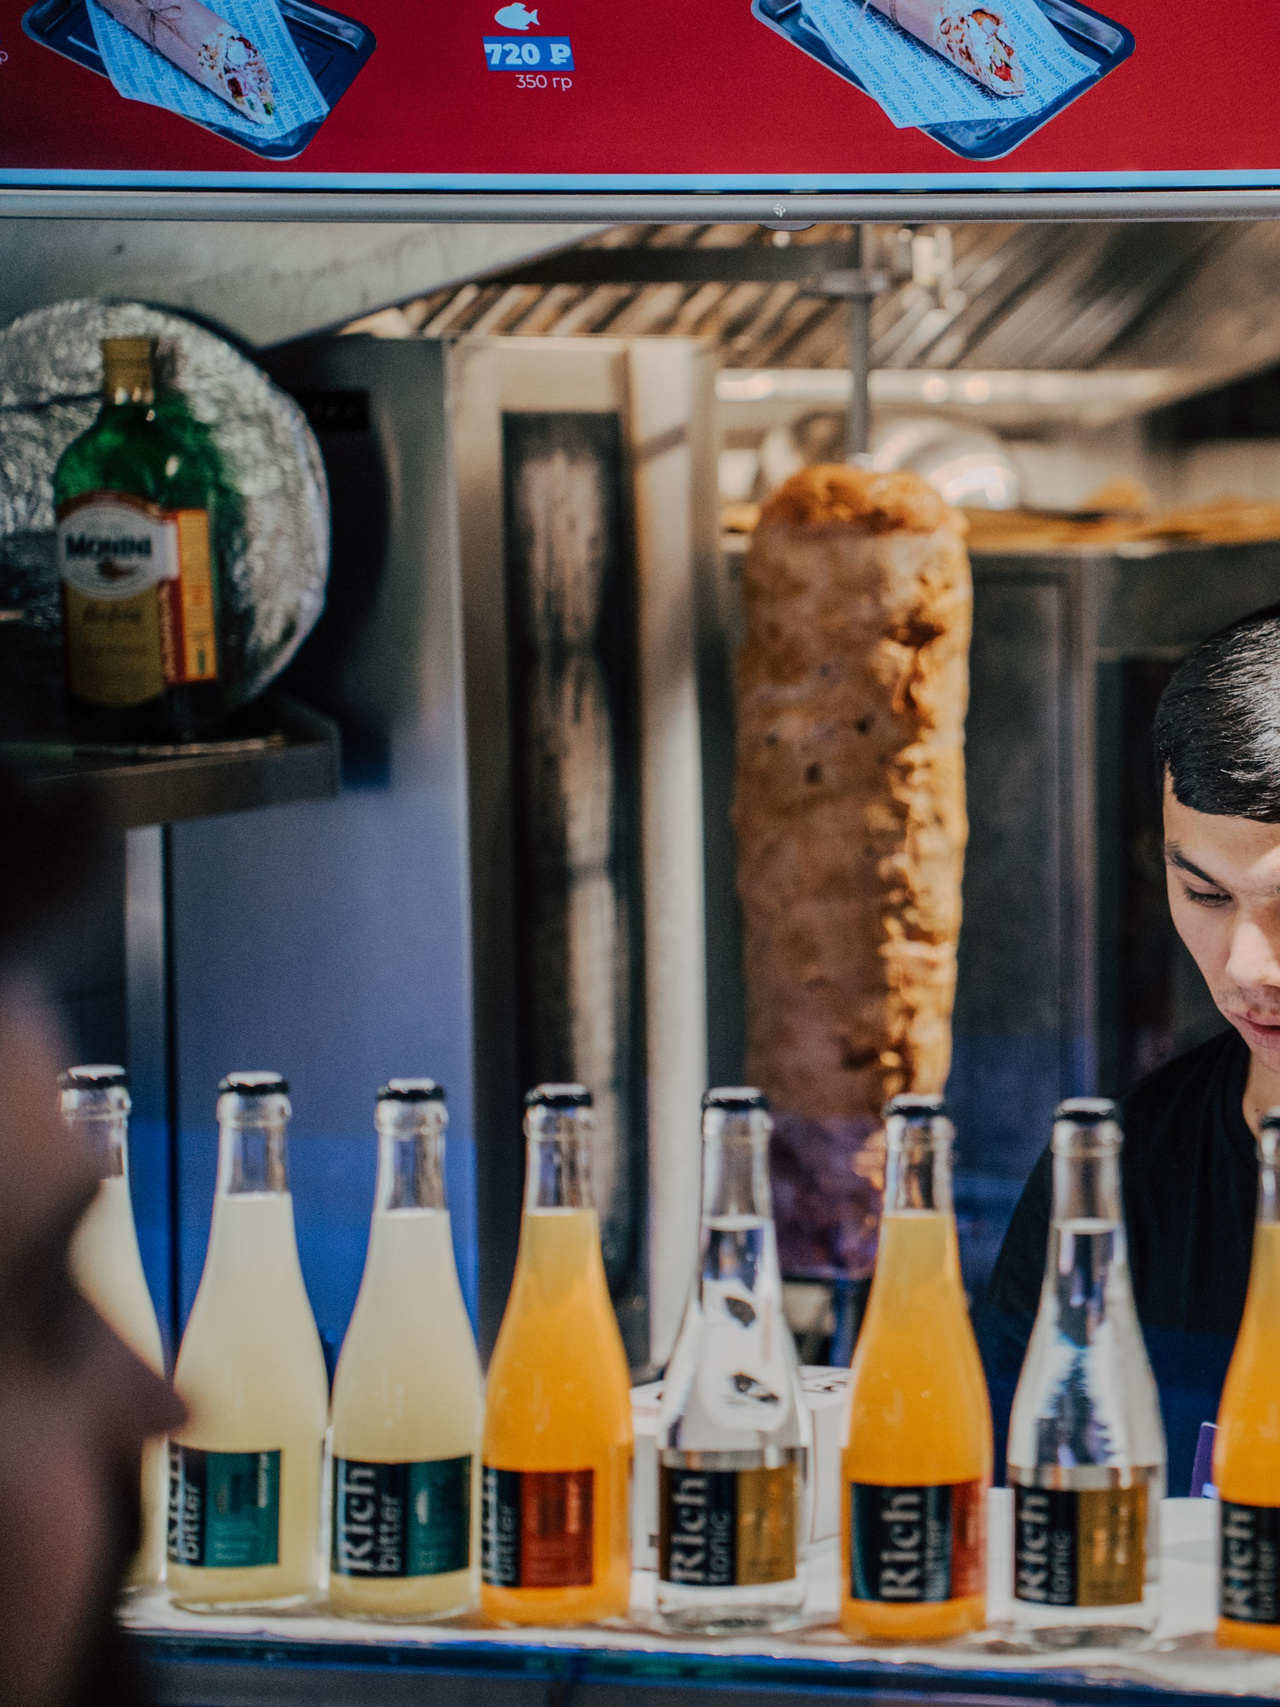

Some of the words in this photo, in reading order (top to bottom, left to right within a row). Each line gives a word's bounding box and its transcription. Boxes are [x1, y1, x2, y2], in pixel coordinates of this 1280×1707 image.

[483, 43, 540, 65] 720
[515, 74, 548, 89] 350
[552, 77, 573, 92] гр
[340, 1467, 376, 1572] Rich
[379, 1493, 401, 1572] bitter
[671, 1477, 708, 1582] Rich
[708, 1510, 732, 1583] tonic
[880, 1492, 923, 1598] Rich
[1018, 1494, 1049, 1601] Rich
[1222, 1509, 1254, 1618] Rich
